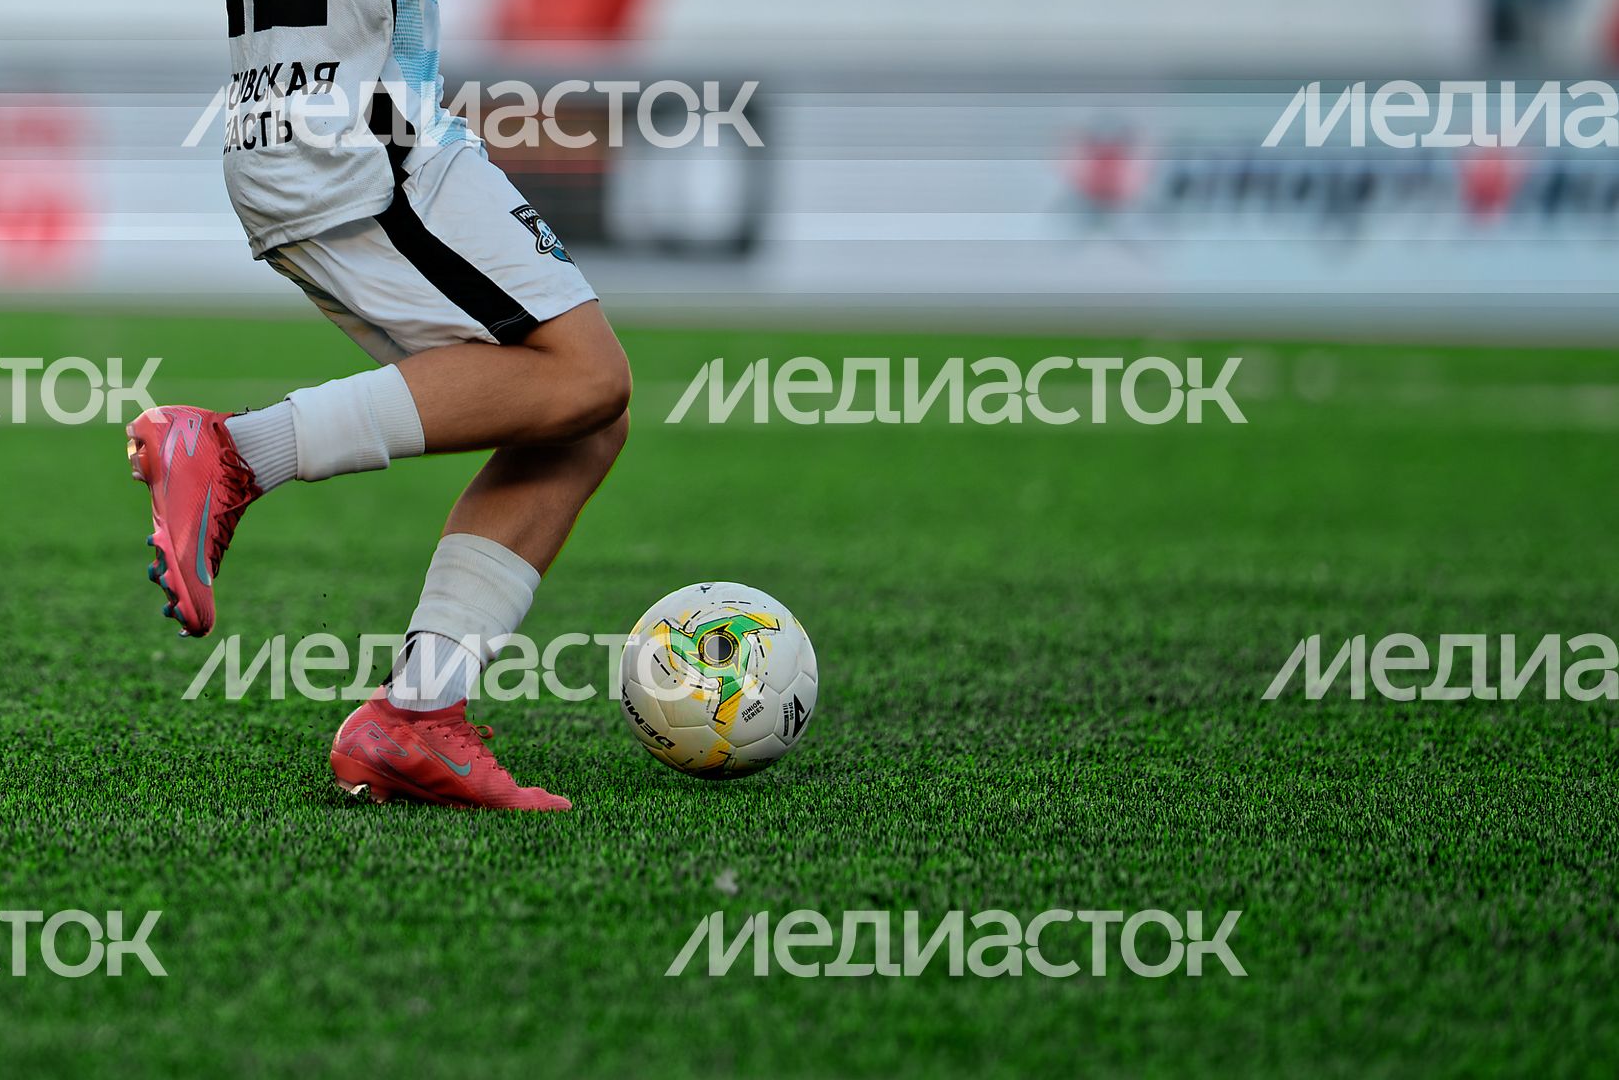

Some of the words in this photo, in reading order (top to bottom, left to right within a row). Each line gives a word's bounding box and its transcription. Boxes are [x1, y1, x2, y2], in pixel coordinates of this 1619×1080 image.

[621, 684, 676, 750] DEMIX
[741, 699, 762, 718] JUNIOR
[743, 704, 765, 723] SERIES
